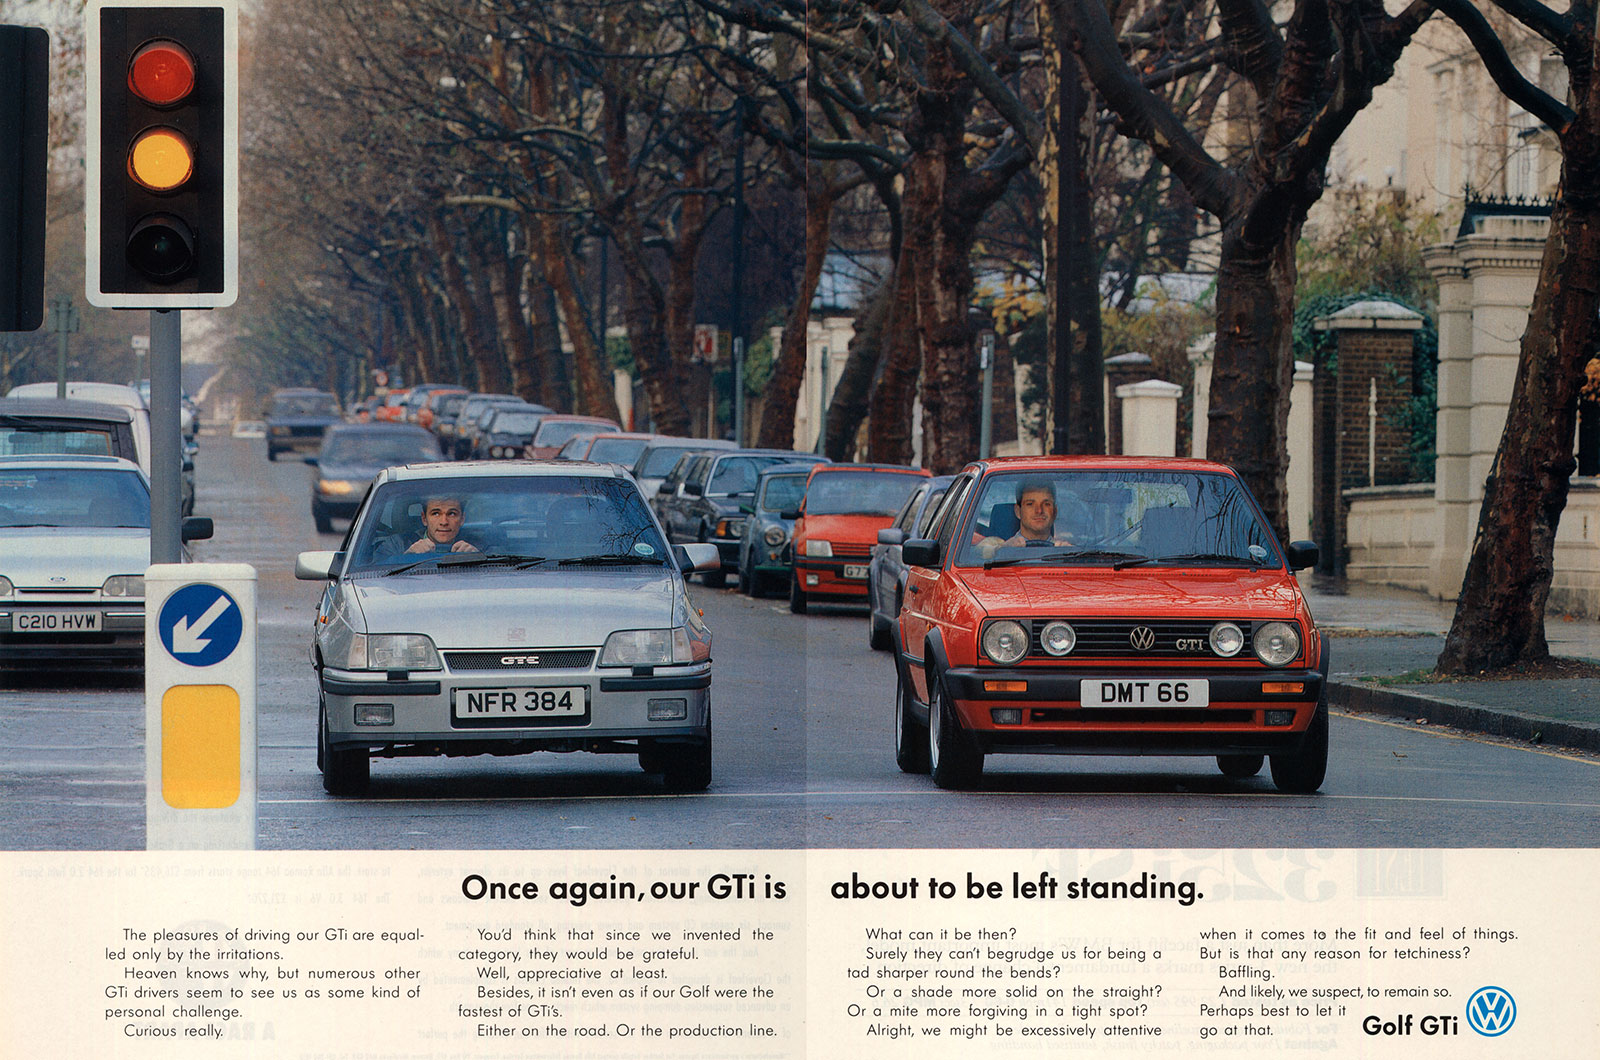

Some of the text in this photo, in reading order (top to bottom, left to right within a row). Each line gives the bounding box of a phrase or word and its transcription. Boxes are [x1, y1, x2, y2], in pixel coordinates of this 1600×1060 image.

[19, 615, 96, 629] C210 HVW
[1175, 638, 1204, 651] GTI
[1101, 682, 1189, 703] DMT 66
[467, 690, 573, 713] NFR 384
[461, 874, 539, 901] Once
[548, 874, 646, 908] again,
[650, 881, 701, 900] our
[707, 873, 755, 900] GTi
[764, 873, 787, 900] is
[830, 871, 920, 900] about
[928, 877, 957, 900] to
[966, 871, 1004, 900] be
[1012, 871, 1059, 900] left
[1066, 871, 1204, 907] standing.
[122, 927, 424, 945] The pleasures of driving our GTi are equal-
[477, 927, 774, 941] You'd think that since we invented the
[865, 927, 1017, 941] What can be then?
[1199, 926, 1518, 944] when comes to the fit and feel of things.
[105, 947, 284, 964] led only by the irritations.
[458, 946, 699, 964] category, they would be grateful.
[866, 945, 1146, 963] Surely they can't begrudge for being
[1200, 945, 1471, 963] But that any reason for tetchiness?
[124, 966, 421, 983] Heaven knows why, but numerous other
[476, 966, 668, 982] Well, appreciative least.
[847, 965, 1061, 982] tad sharper round the bends?
[1219, 964, 1275, 982] Baffling.
[104, 984, 421, 999] GTi drivers seem to see some kind of
[477, 984, 774, 1000] Besides, isn't even our Golf were the
[866, 984, 1163, 1001] Or shade more solid on the straight?
[1218, 984, 1452, 1001] And likely, we suspect, to remain so.
[105, 1004, 243, 1021] personal challenge.
[458, 1003, 563, 1018] fastest of GTi's.
[847, 1003, 1148, 1021] Or mite more forgiving tight spot?
[1200, 1003, 1332, 1020] Perhaps best to let
[124, 1023, 223, 1040] Curious really.
[477, 1023, 777, 1040] Either on the road. Or the production line.
[866, 1023, 1162, 1040] Alright, we might be excessively attentive
[1199, 1023, 1274, 1040] go that.
[1362, 1013, 1458, 1036] Golf GTi
